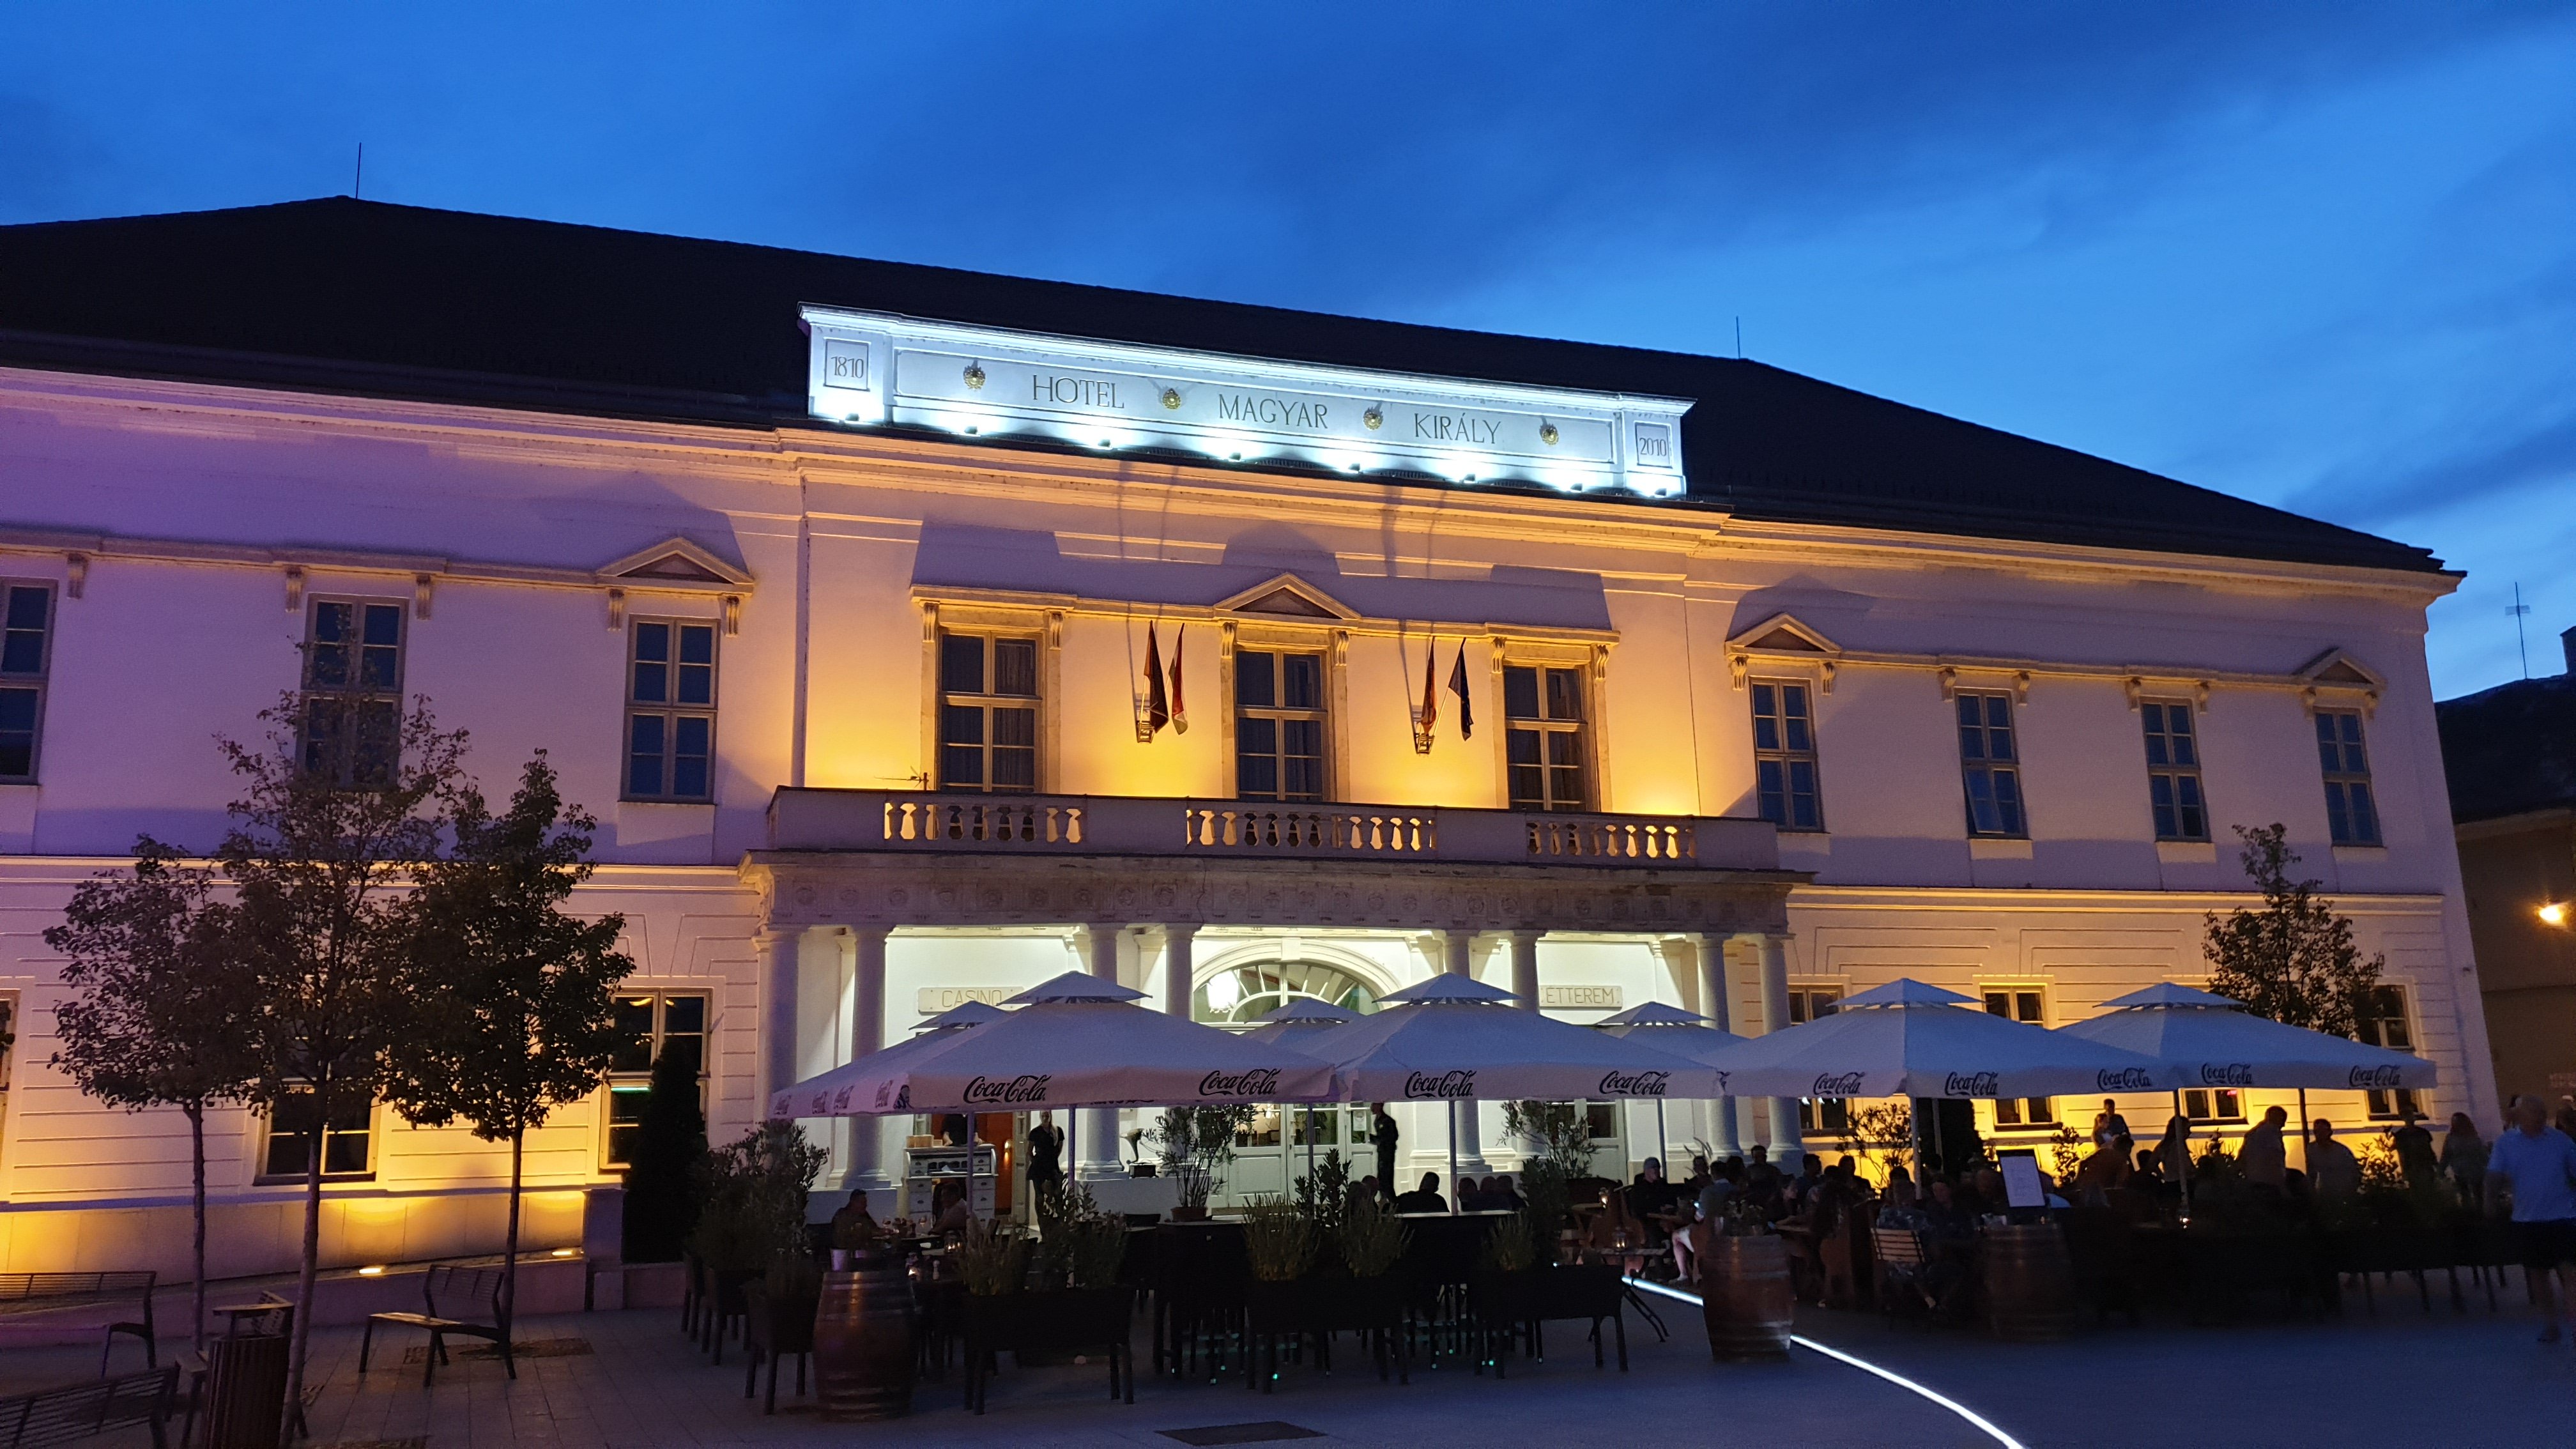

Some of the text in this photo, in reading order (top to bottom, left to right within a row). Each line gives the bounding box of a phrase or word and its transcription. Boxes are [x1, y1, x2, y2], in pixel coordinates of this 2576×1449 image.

[831, 355, 864, 379] 1810
[1032, 374, 1502, 445] HOTEL MAGYAR KIRÁLY
[1639, 438, 1667, 456] 2010
[963, 1075, 1052, 1103] Coca-Cola
[1199, 1068, 1283, 1096] Coca-Cola
[1405, 1070, 1477, 1098] Coca-Cola
[1599, 1070, 1672, 1096] Coca-Cola
